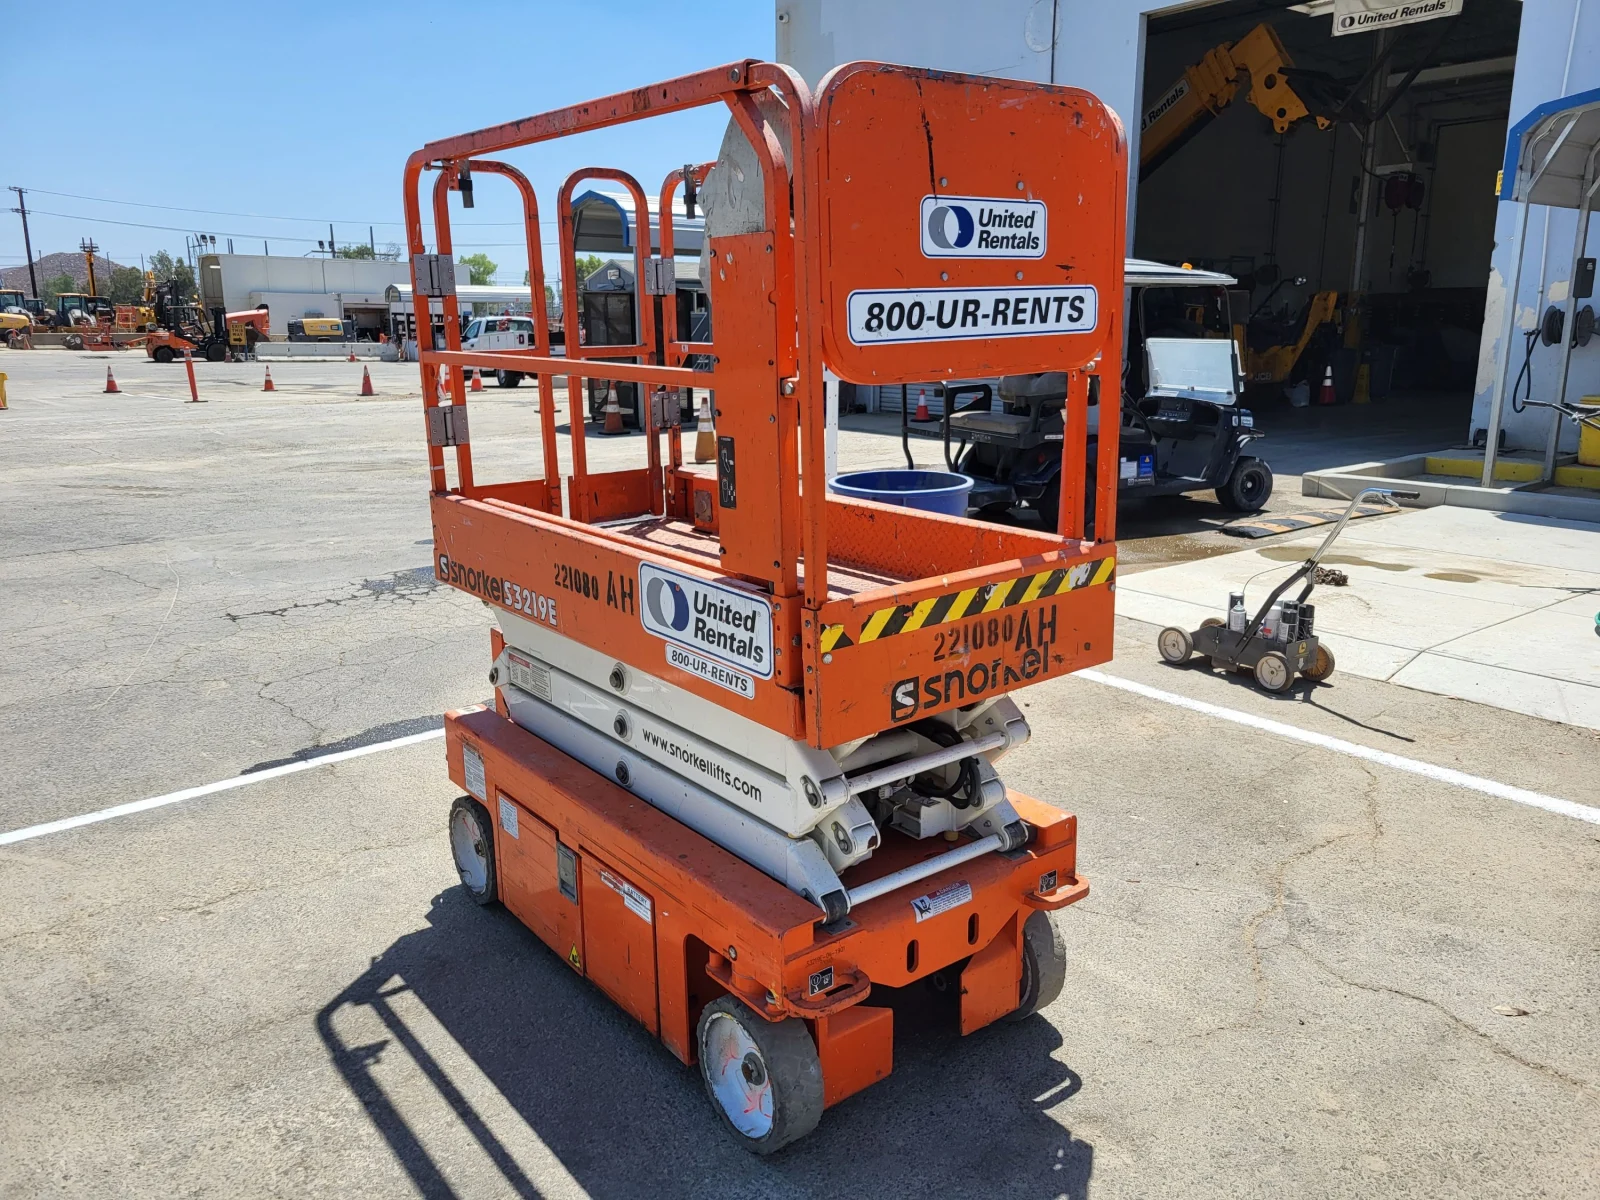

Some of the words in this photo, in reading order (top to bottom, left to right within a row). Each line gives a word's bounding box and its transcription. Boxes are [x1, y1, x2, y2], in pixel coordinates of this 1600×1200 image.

[1357, 9, 1399, 25] United
[1400, 0, 1446, 18] Rentals
[1148, 86, 1185, 124] Rentals
[977, 229, 1040, 250] Rentals
[978, 208, 1036, 230] United
[864, 295, 1086, 333] 800-UR-RENTS
[450, 560, 505, 604] snorkel
[503, 580, 558, 627] S3219E
[553, 562, 599, 601] 221080
[606, 570, 635, 616] AH
[693, 590, 757, 634] United
[693, 616, 764, 664] Rentals
[671, 649, 748, 692] 800-UR-RENTS
[642, 728, 762, 803] www.snorkellifts.com
